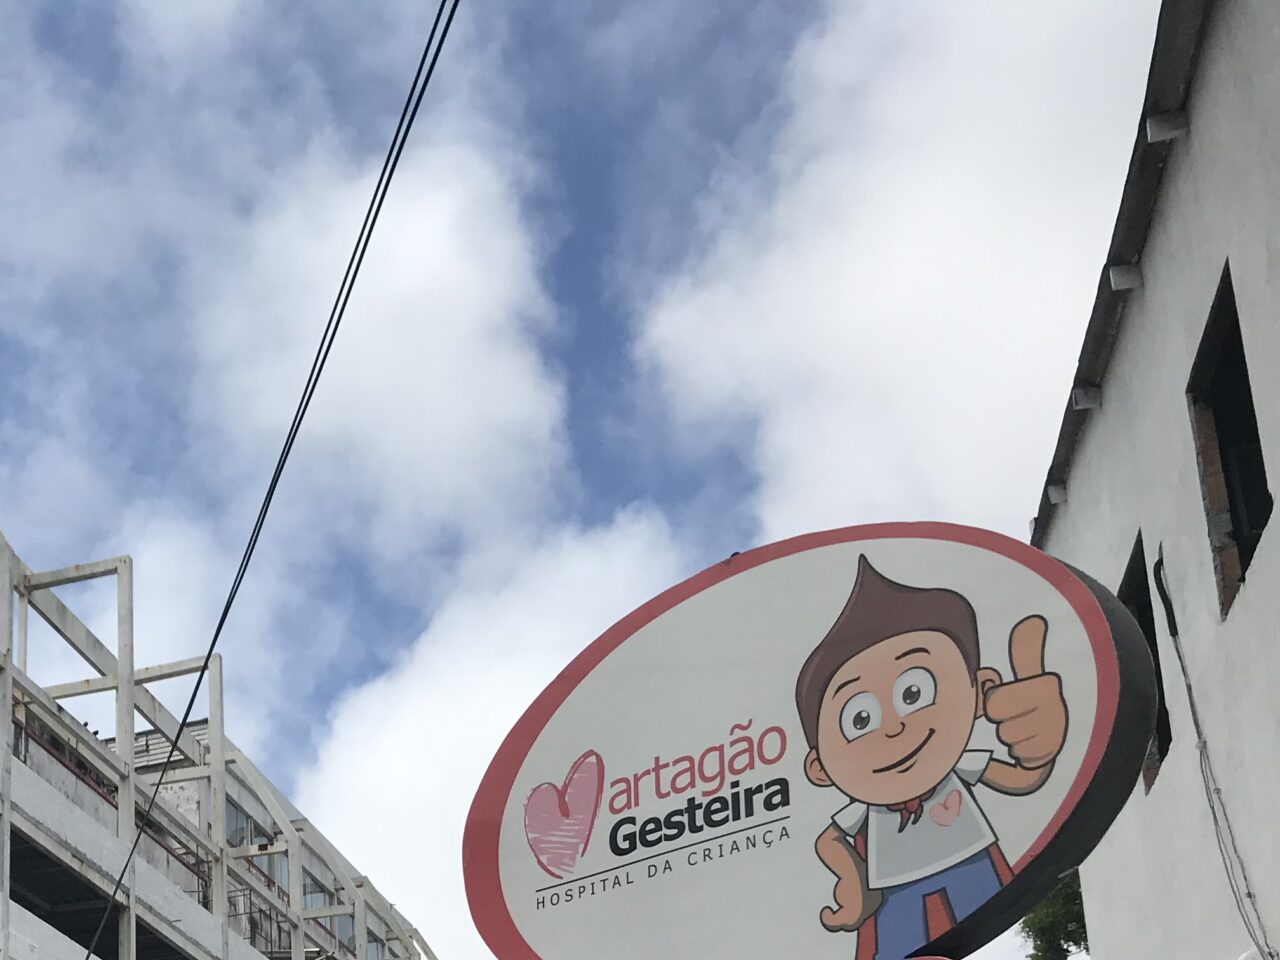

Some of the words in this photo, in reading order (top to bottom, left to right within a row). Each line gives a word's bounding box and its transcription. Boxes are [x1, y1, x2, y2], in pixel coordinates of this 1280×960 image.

[609, 777, 791, 857] Gesteira
[535, 871, 634, 911] HOSPITAL
[647, 859, 673, 878] DA
[687, 826, 791, 867] CRIANÇA
